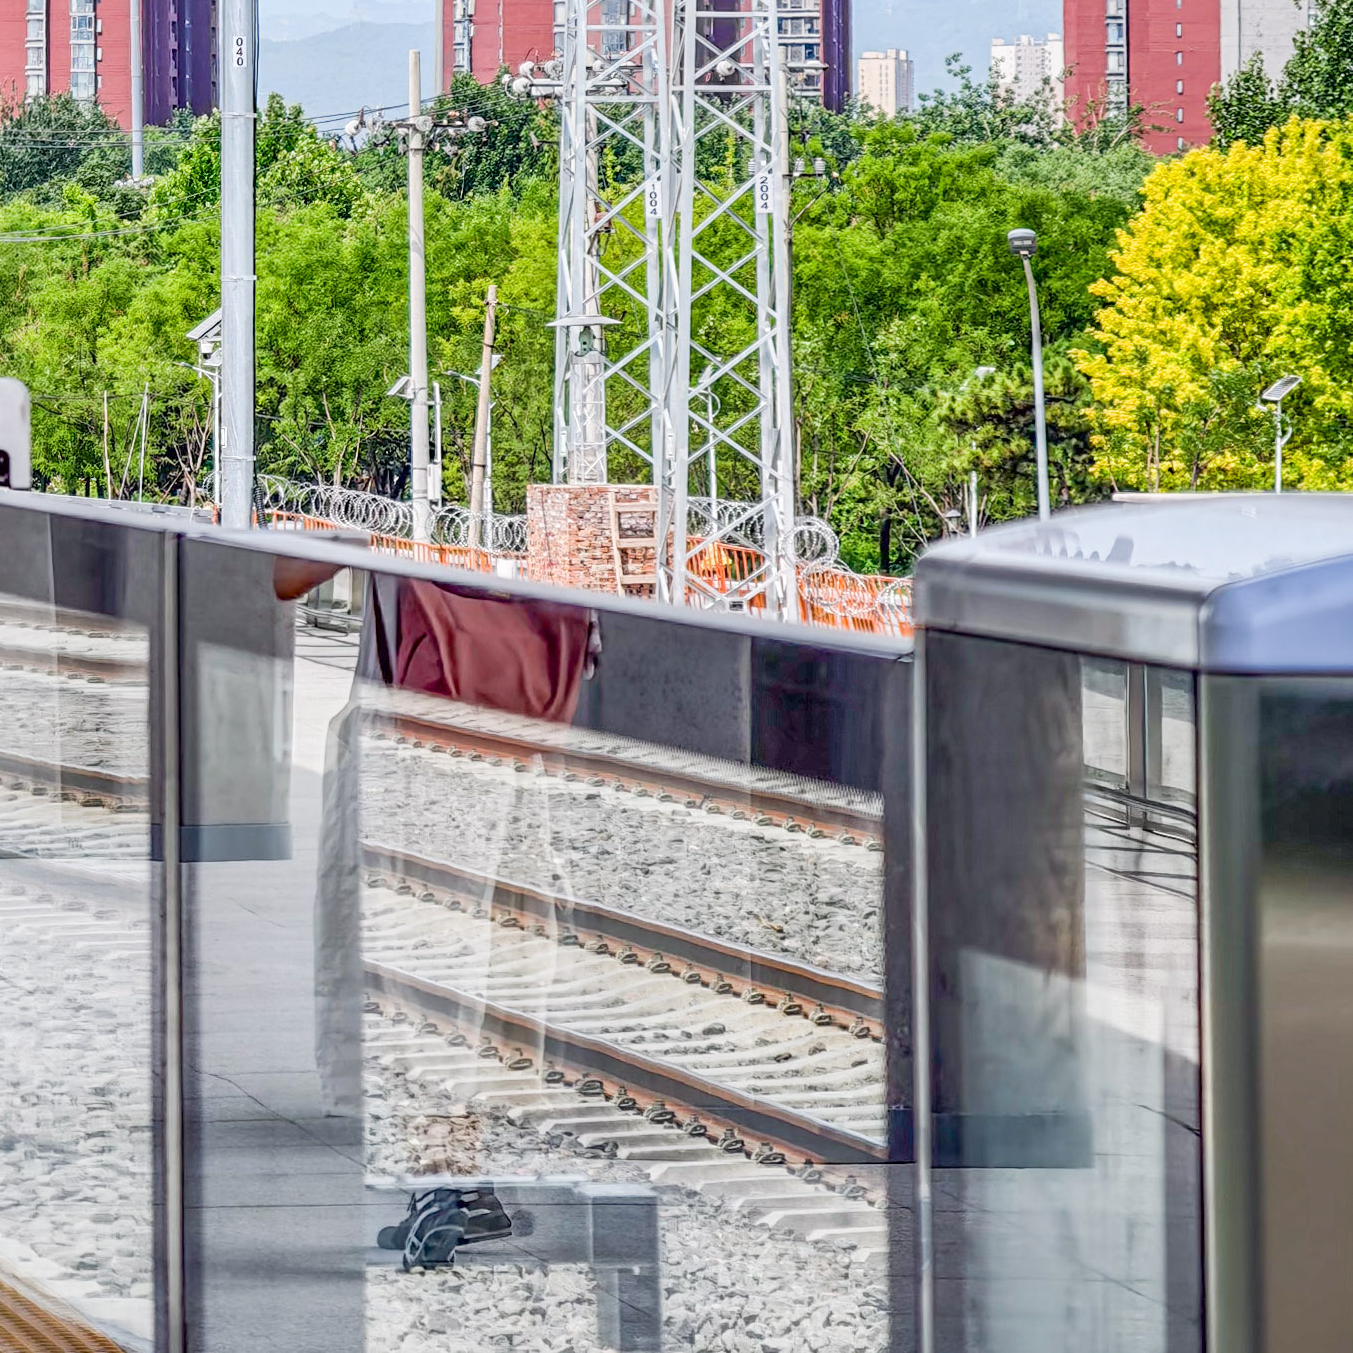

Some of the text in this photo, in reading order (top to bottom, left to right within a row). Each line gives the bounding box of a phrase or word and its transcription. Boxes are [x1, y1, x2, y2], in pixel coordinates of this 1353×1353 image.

[236, 37, 244, 66] 040
[649, 183, 658, 215] 1004
[760, 175, 769, 210] 2004
